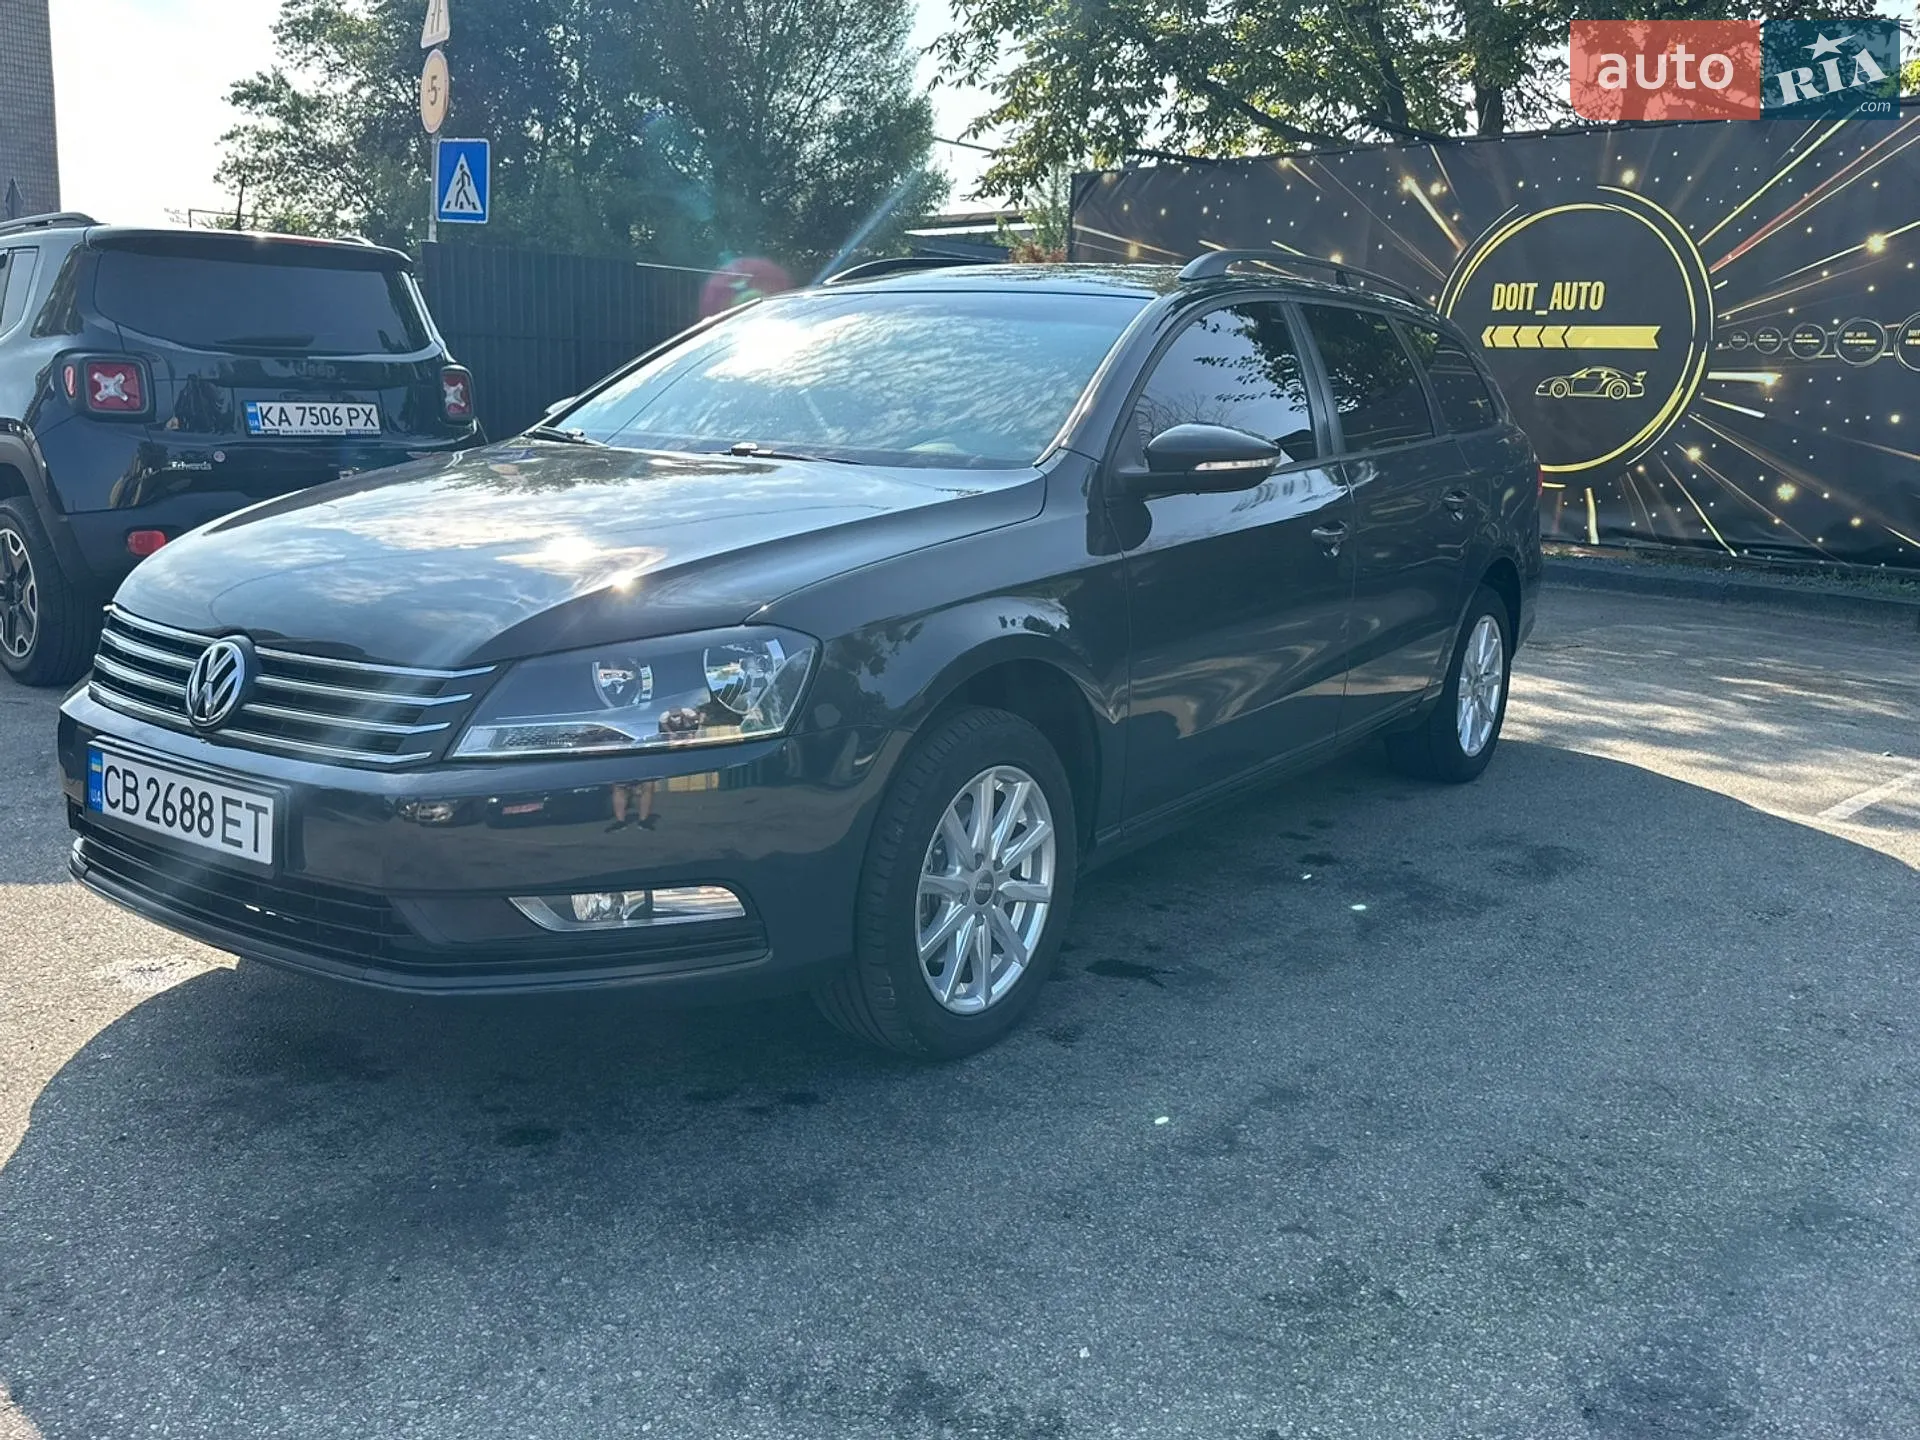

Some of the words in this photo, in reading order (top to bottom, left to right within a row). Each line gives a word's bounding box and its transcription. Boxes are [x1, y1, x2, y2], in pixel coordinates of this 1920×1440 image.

[429, 75, 438, 105] 5
[1491, 281, 1606, 315] DOIT_AUTO
[260, 406, 292, 427] KA
[296, 406, 343, 427] 7506
[347, 407, 376, 427] PX
[104, 765, 139, 815] CB
[145, 777, 215, 838] 2688
[221, 796, 269, 853] ET
